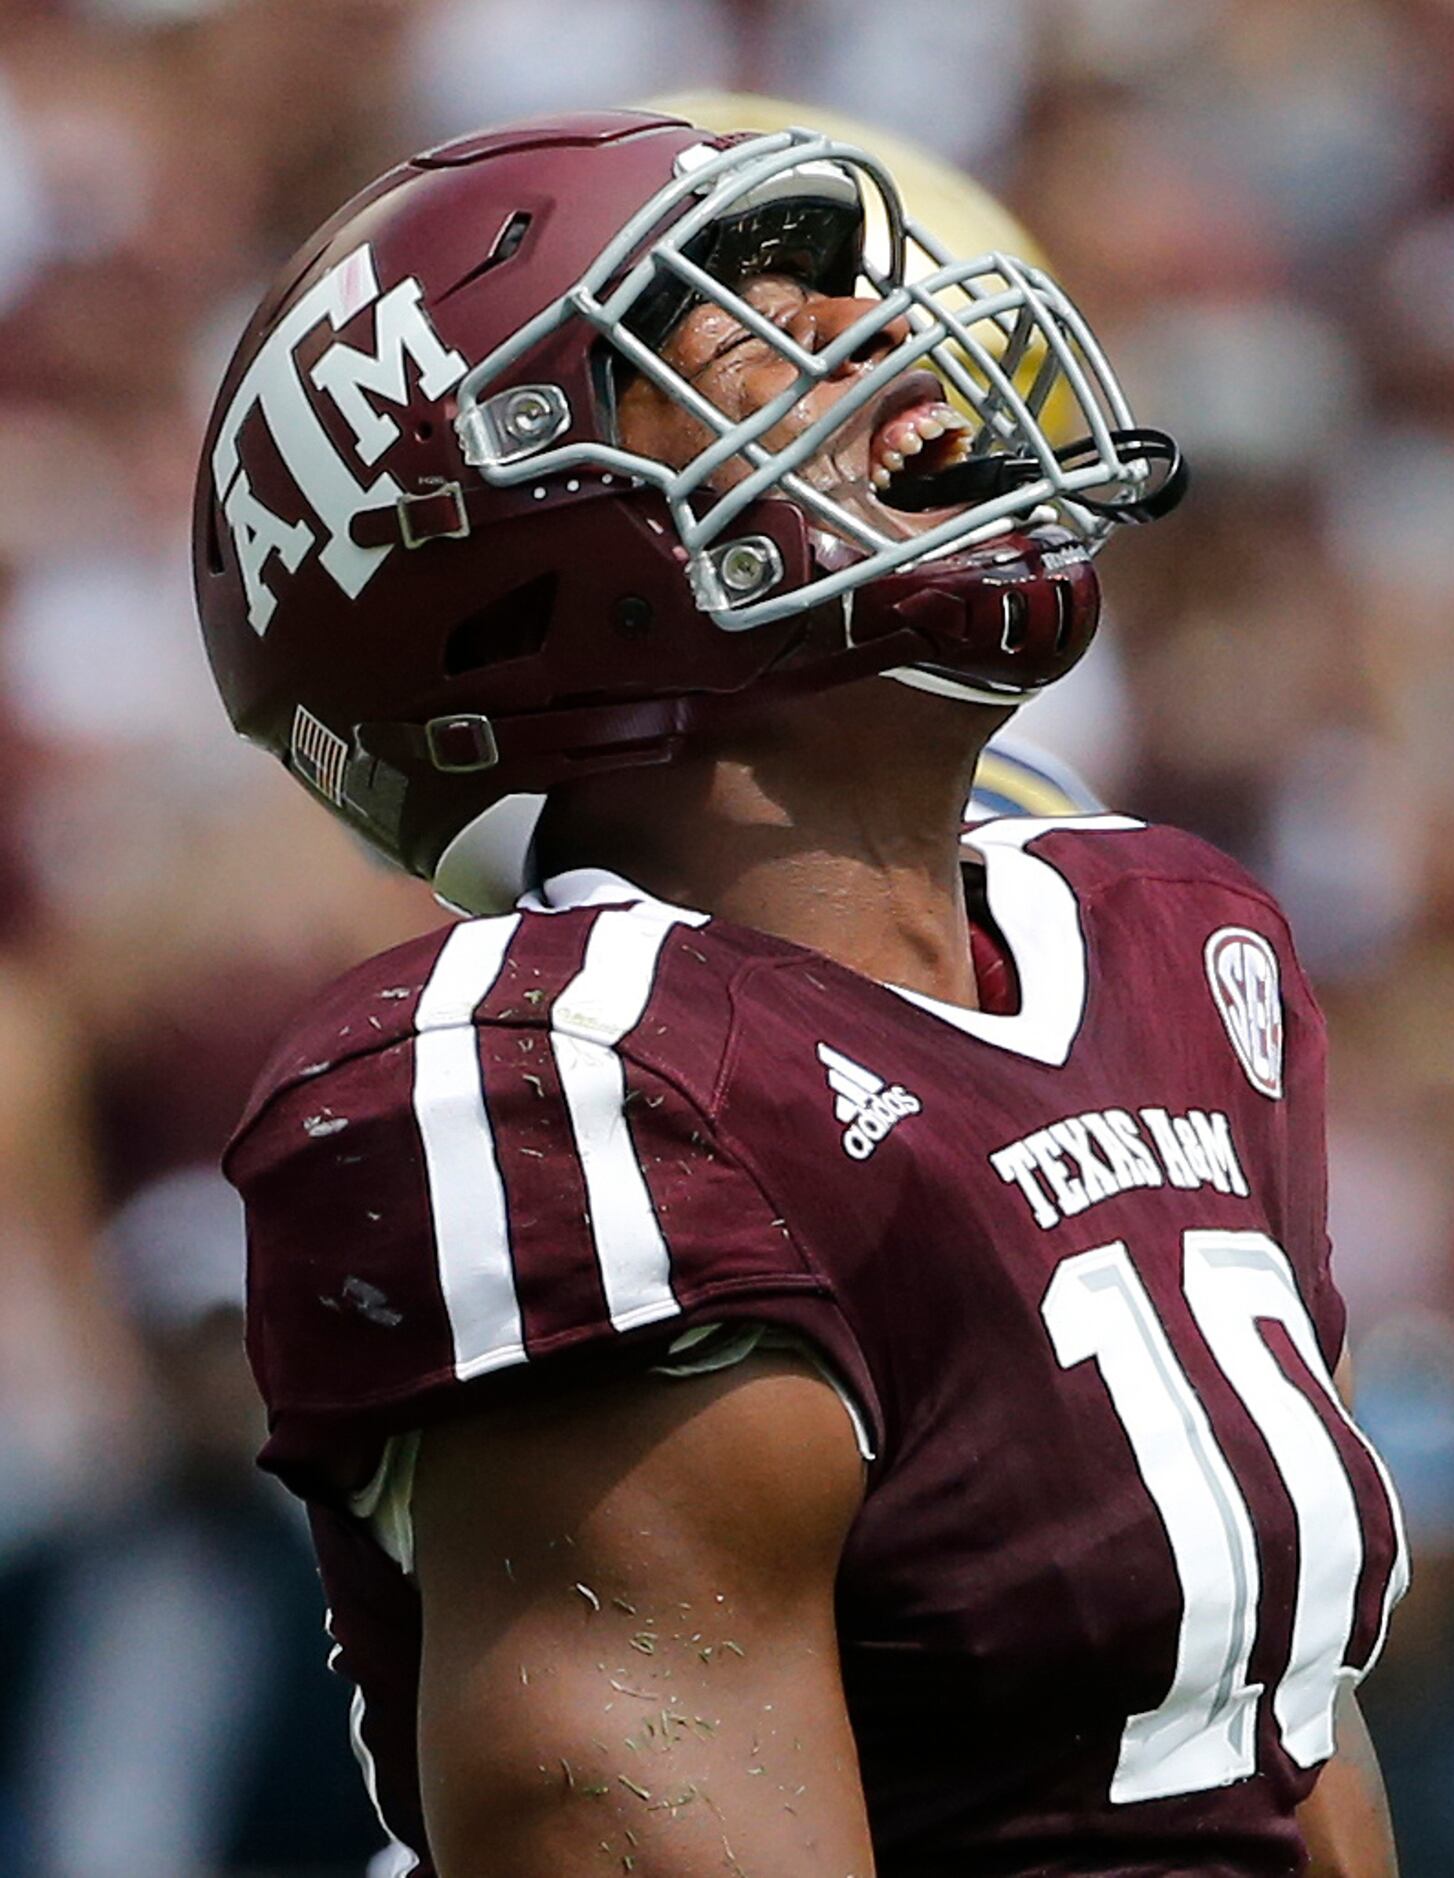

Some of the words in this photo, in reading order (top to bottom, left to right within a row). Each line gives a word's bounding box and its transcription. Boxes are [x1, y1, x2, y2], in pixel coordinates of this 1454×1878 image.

[843, 1085, 921, 1160] adidas
[988, 1107, 1163, 1229] TEXAS
[1138, 1107, 1250, 1197] A&M
[1041, 1230, 1411, 1804] 10
